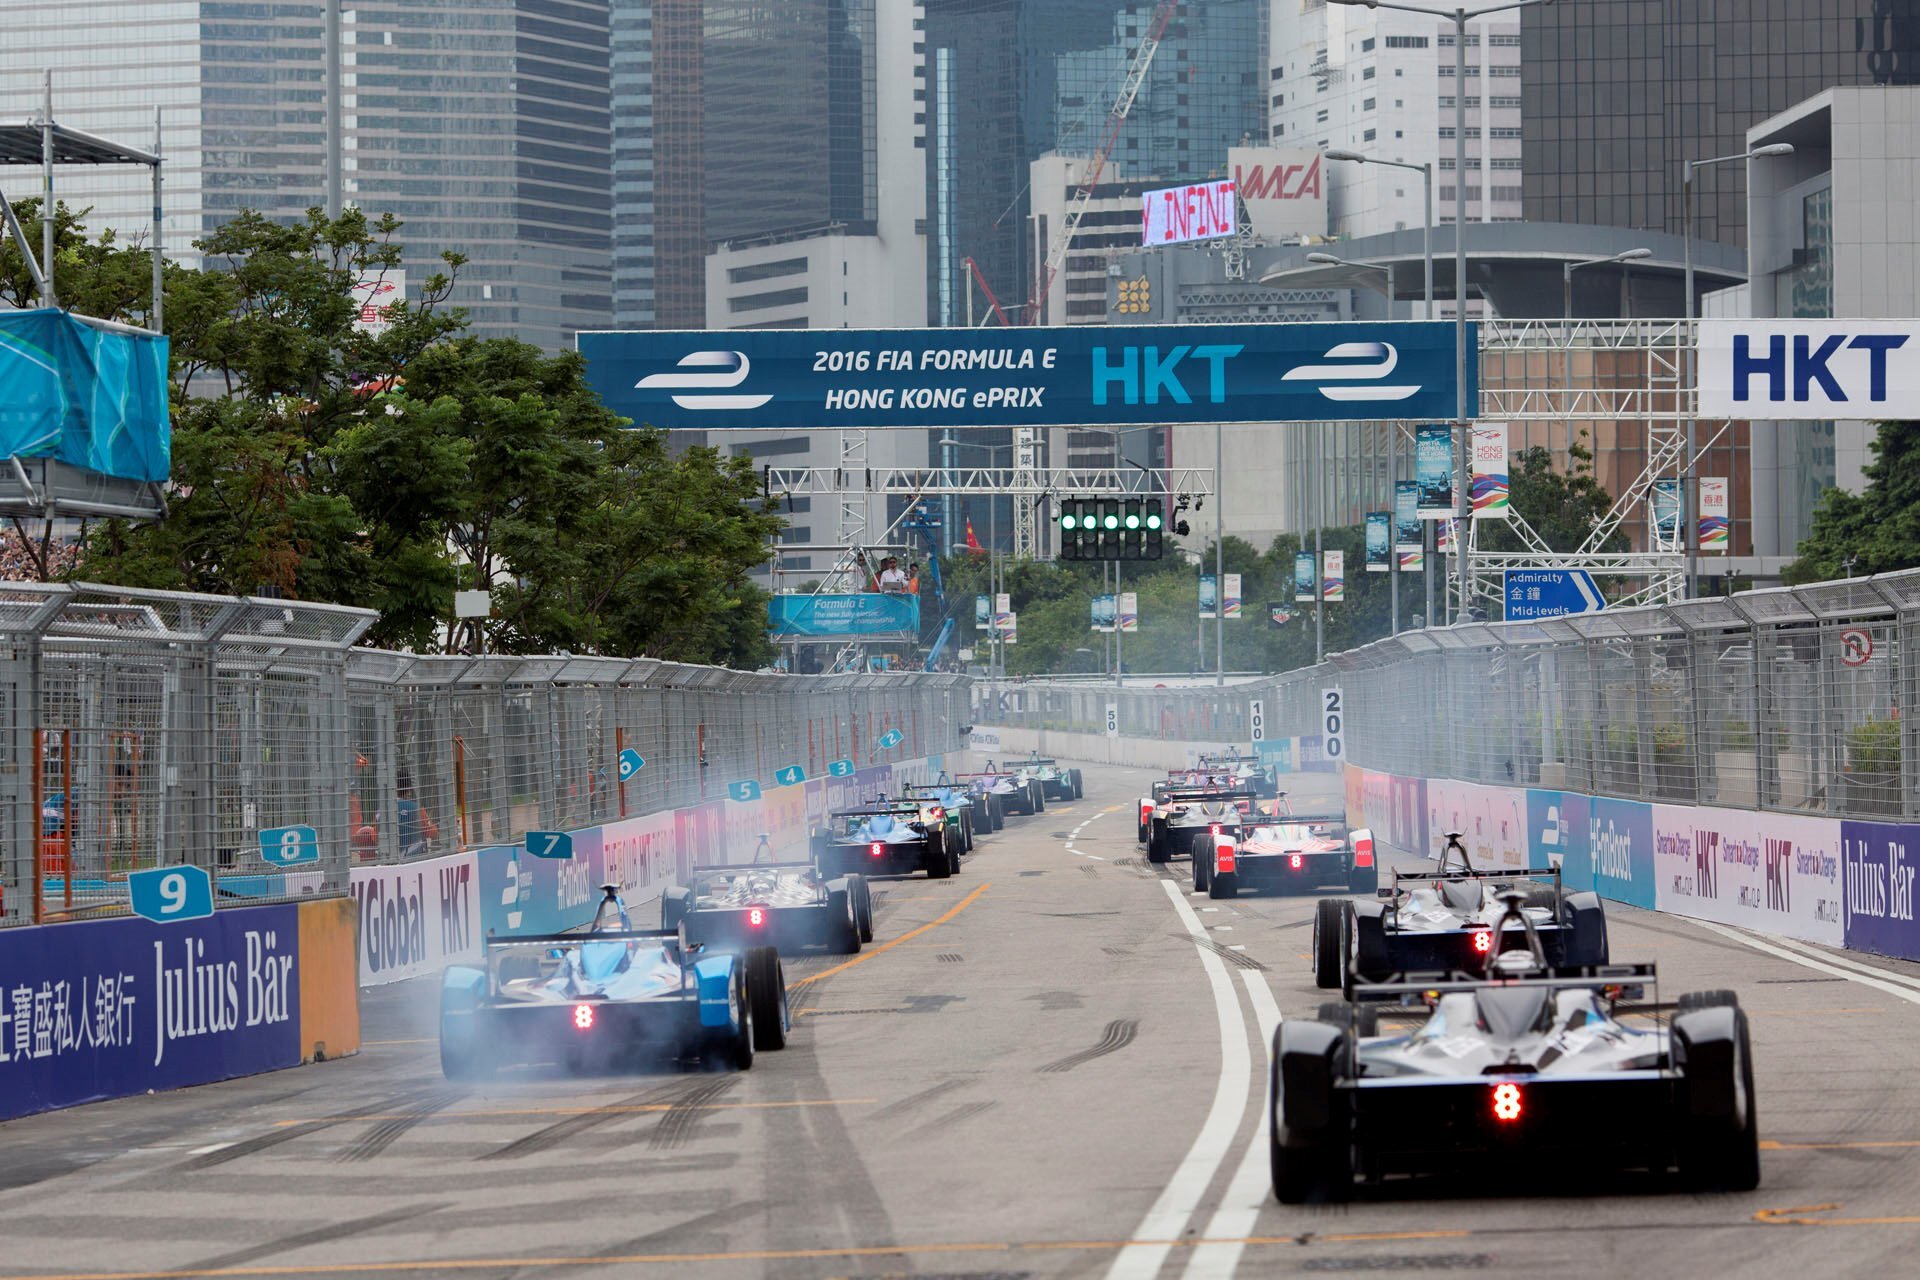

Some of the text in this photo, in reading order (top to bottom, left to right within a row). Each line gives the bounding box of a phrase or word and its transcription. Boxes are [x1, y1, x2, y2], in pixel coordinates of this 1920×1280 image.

[1234, 153, 1321, 200] YMCA
[813, 348, 1058, 372] 2016 FIA FORMULA E
[1732, 333, 1911, 402] HKT
[1092, 344, 1245, 405] HKT
[825, 386, 1046, 410] HONG KONG ePRIX
[1509, 572, 1563, 584] Admiralty
[814, 598, 866, 609] Formula E
[1510, 586, 1541, 601] 金鐘
[1512, 606, 1570, 617] Mid-levels
[1107, 710, 1116, 732] 50
[1252, 702, 1263, 740] 100
[1325, 692, 1341, 757] 200
[887, 732, 897, 745] 2
[785, 768, 797, 782] 4
[838, 762, 848, 776] 3
[739, 783, 751, 799] 5
[280, 830, 301, 860] 8
[543, 835, 560, 855] 7
[1695, 830, 1719, 899] HKT
[1765, 838, 1792, 913] HKT
[159, 873, 187, 914] 9
[1845, 839, 1915, 931] Julius Bär
[439, 863, 471, 956] HKT
[154, 930, 293, 1067] Julius Bär
